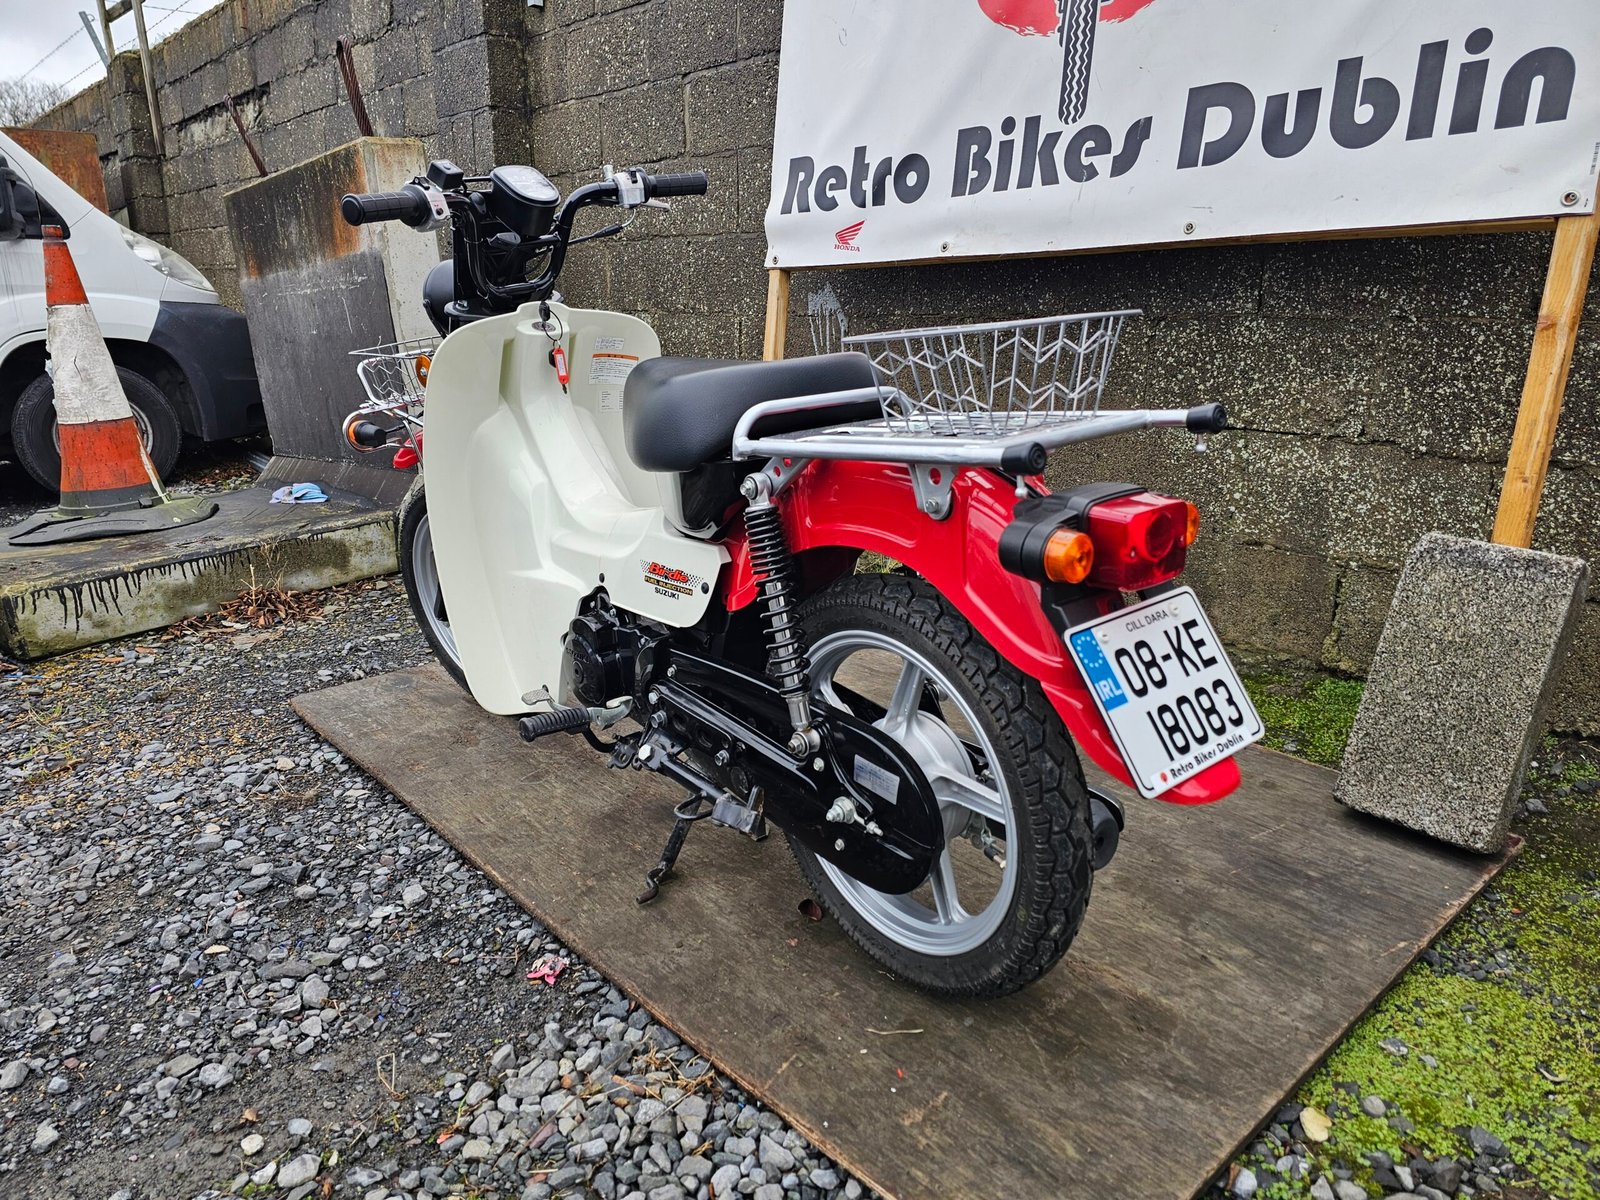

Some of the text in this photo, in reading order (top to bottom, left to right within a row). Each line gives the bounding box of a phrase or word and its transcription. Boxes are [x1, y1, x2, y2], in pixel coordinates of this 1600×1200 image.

[780, 26, 1577, 215] Retro Bikes Dublin
[833, 244, 861, 252] HONDA
[648, 561, 690, 583] Birdie
[645, 576, 693, 596] FUEL INJECTION
[654, 586, 680, 600] SUZUKI
[1125, 609, 1169, 632] CILL DARA
[1114, 618, 1219, 698] 08-KE
[1095, 678, 1122, 702] IRL
[1146, 678, 1245, 762] 18083
[1170, 733, 1245, 779] Retro Bikes Dublin
